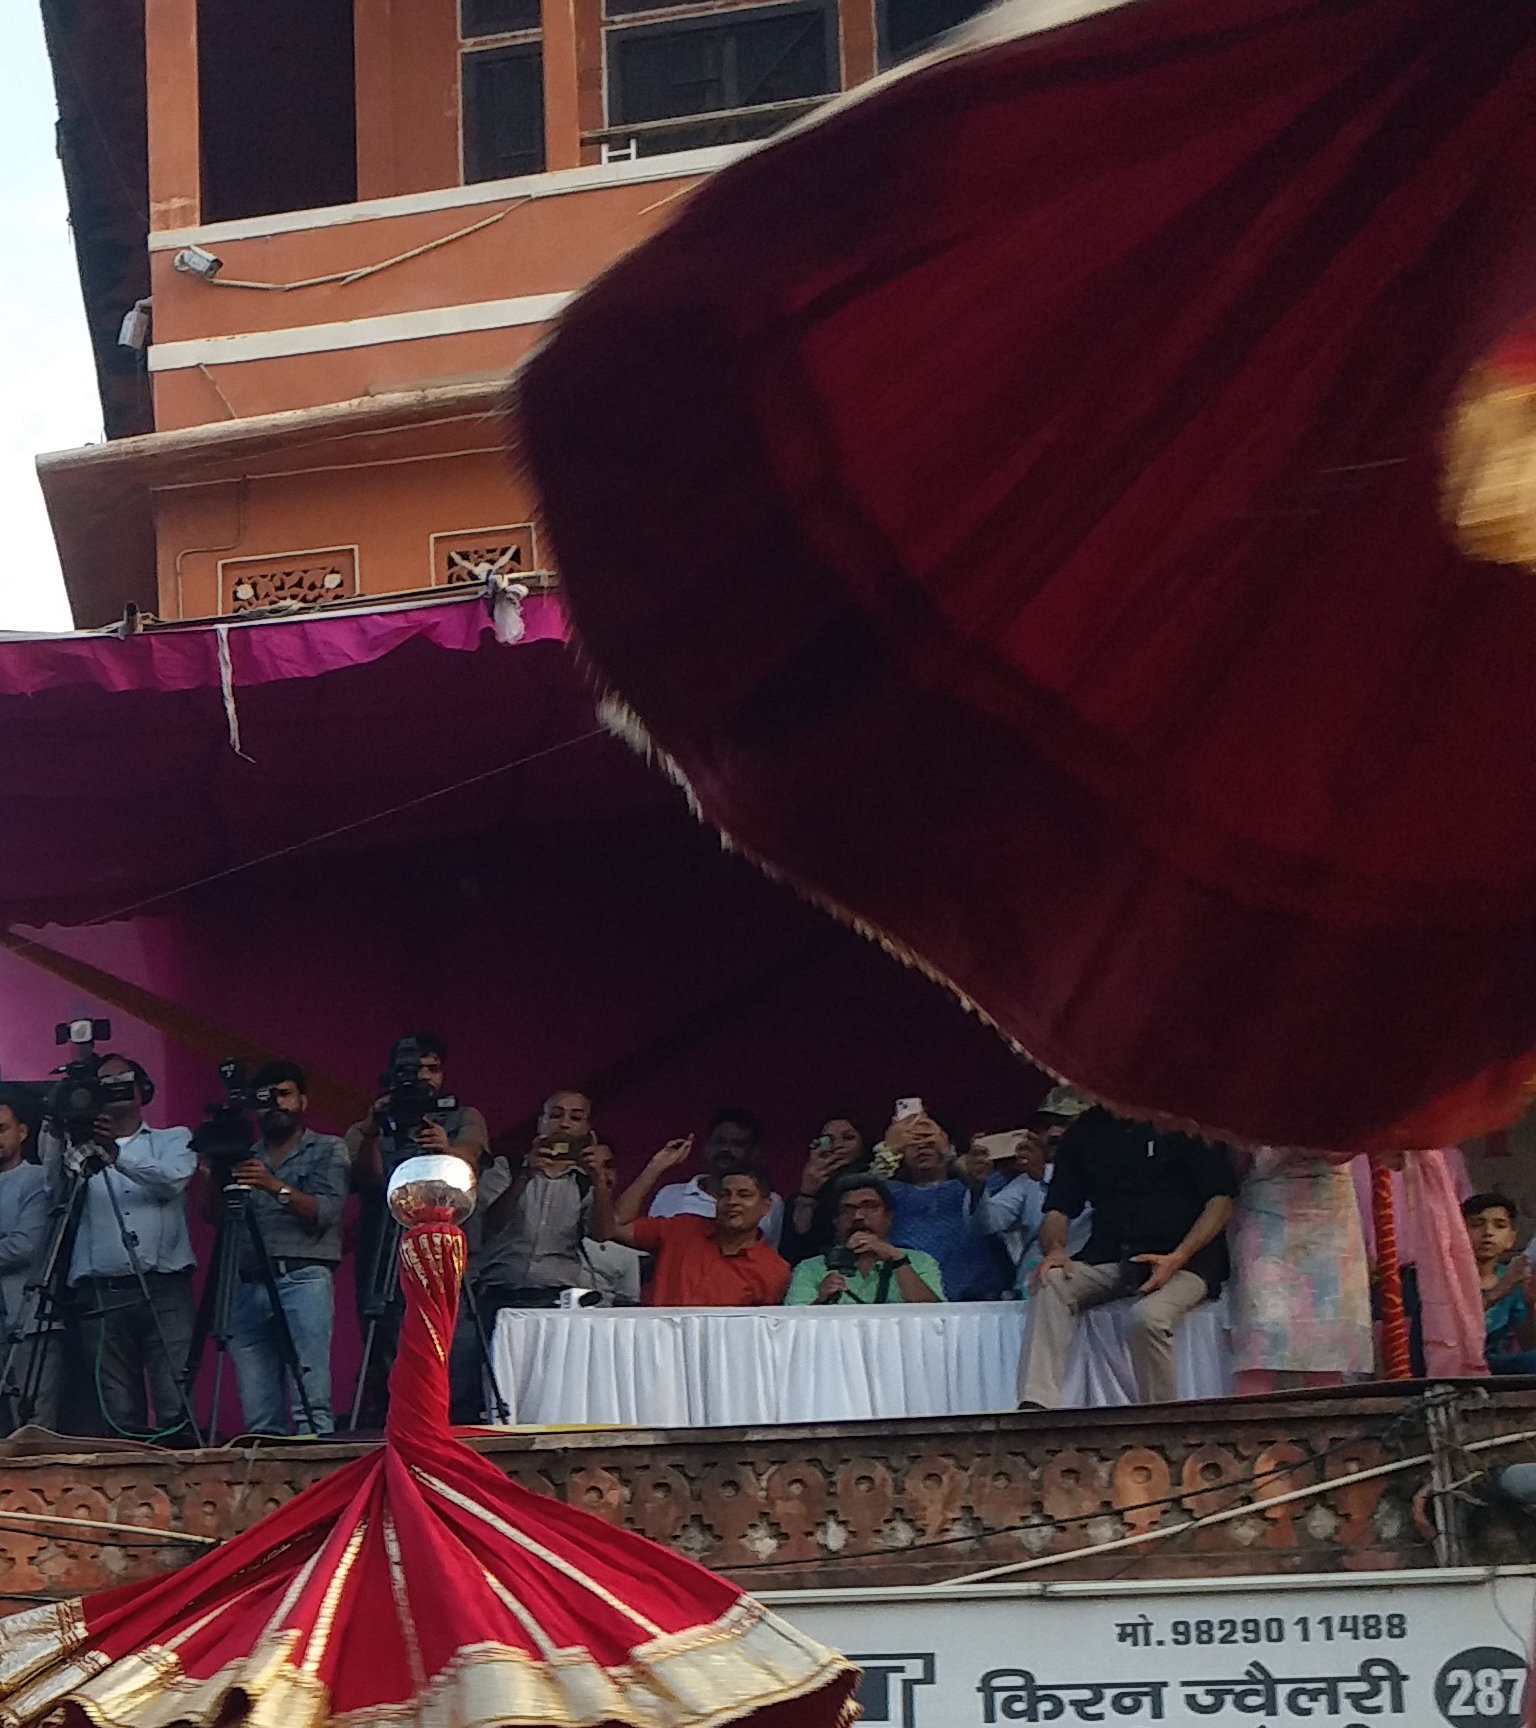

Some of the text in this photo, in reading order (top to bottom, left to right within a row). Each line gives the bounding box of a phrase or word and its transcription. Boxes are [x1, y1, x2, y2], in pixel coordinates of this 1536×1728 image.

[976, 1668, 1170, 1723] किरन
[1180, 1658, 1410, 1716] ज्वैलरी
[1446, 1668, 1528, 1716] 287
